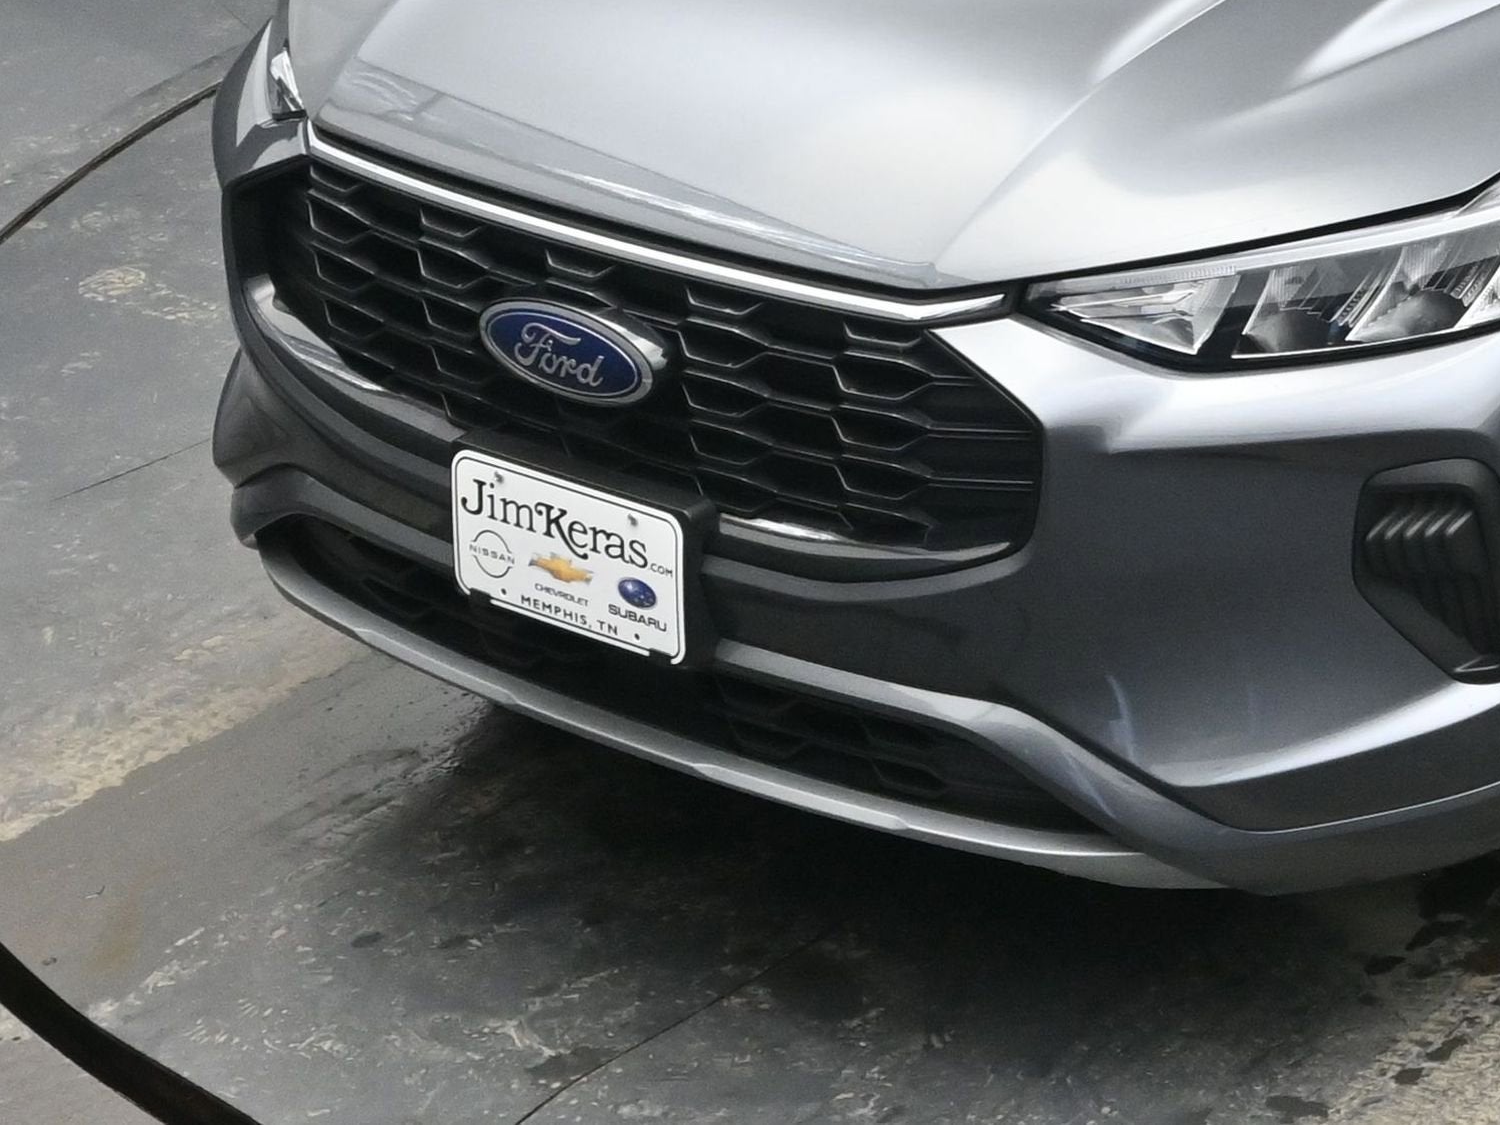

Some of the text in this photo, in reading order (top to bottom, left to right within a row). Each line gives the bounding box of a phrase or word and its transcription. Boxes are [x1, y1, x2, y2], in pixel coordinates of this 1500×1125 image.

[514, 322, 605, 387] Ford
[469, 544, 516, 565] NISSAN
[534, 582, 589, 607] CHEVROLET
[520, 595, 619, 636] MEMPHIS, TN
[608, 603, 668, 633] SUBARU
